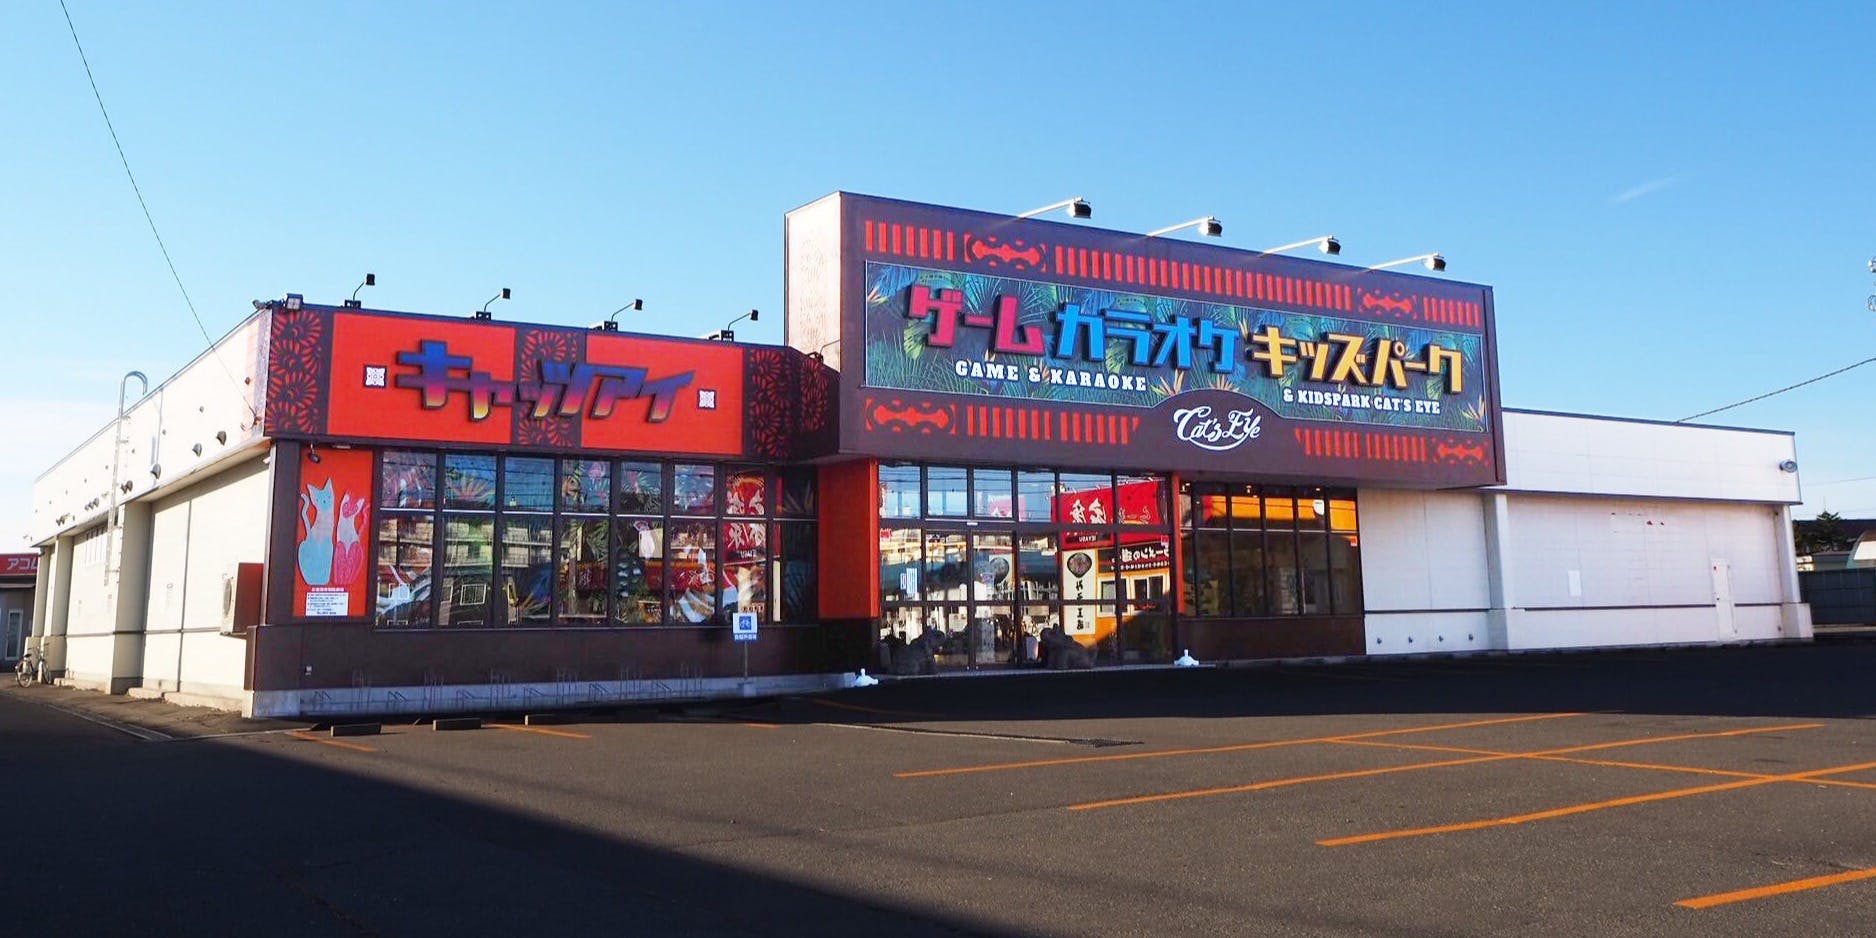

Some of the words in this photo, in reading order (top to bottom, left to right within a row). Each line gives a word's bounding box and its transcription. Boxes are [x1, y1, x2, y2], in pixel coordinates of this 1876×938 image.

[909, 284, 1045, 355] ゲーム
[1055, 303, 1241, 374] カラオケ
[1251, 325, 1463, 394] キッズパーク
[396, 339, 696, 422] キャッツアイ
[955, 360, 1019, 381] GAME
[1028, 367, 1041, 383] &
[1050, 369, 1147, 392] KARAOKE
[1283, 388, 1293, 402] &
[1298, 389, 1371, 409] KIDSPARK
[1374, 395, 1412, 413] CAT'S
[1415, 400, 1441, 415] EYE
[1173, 406, 1223, 441] Cat's
[1221, 408, 1262, 441] Eye
